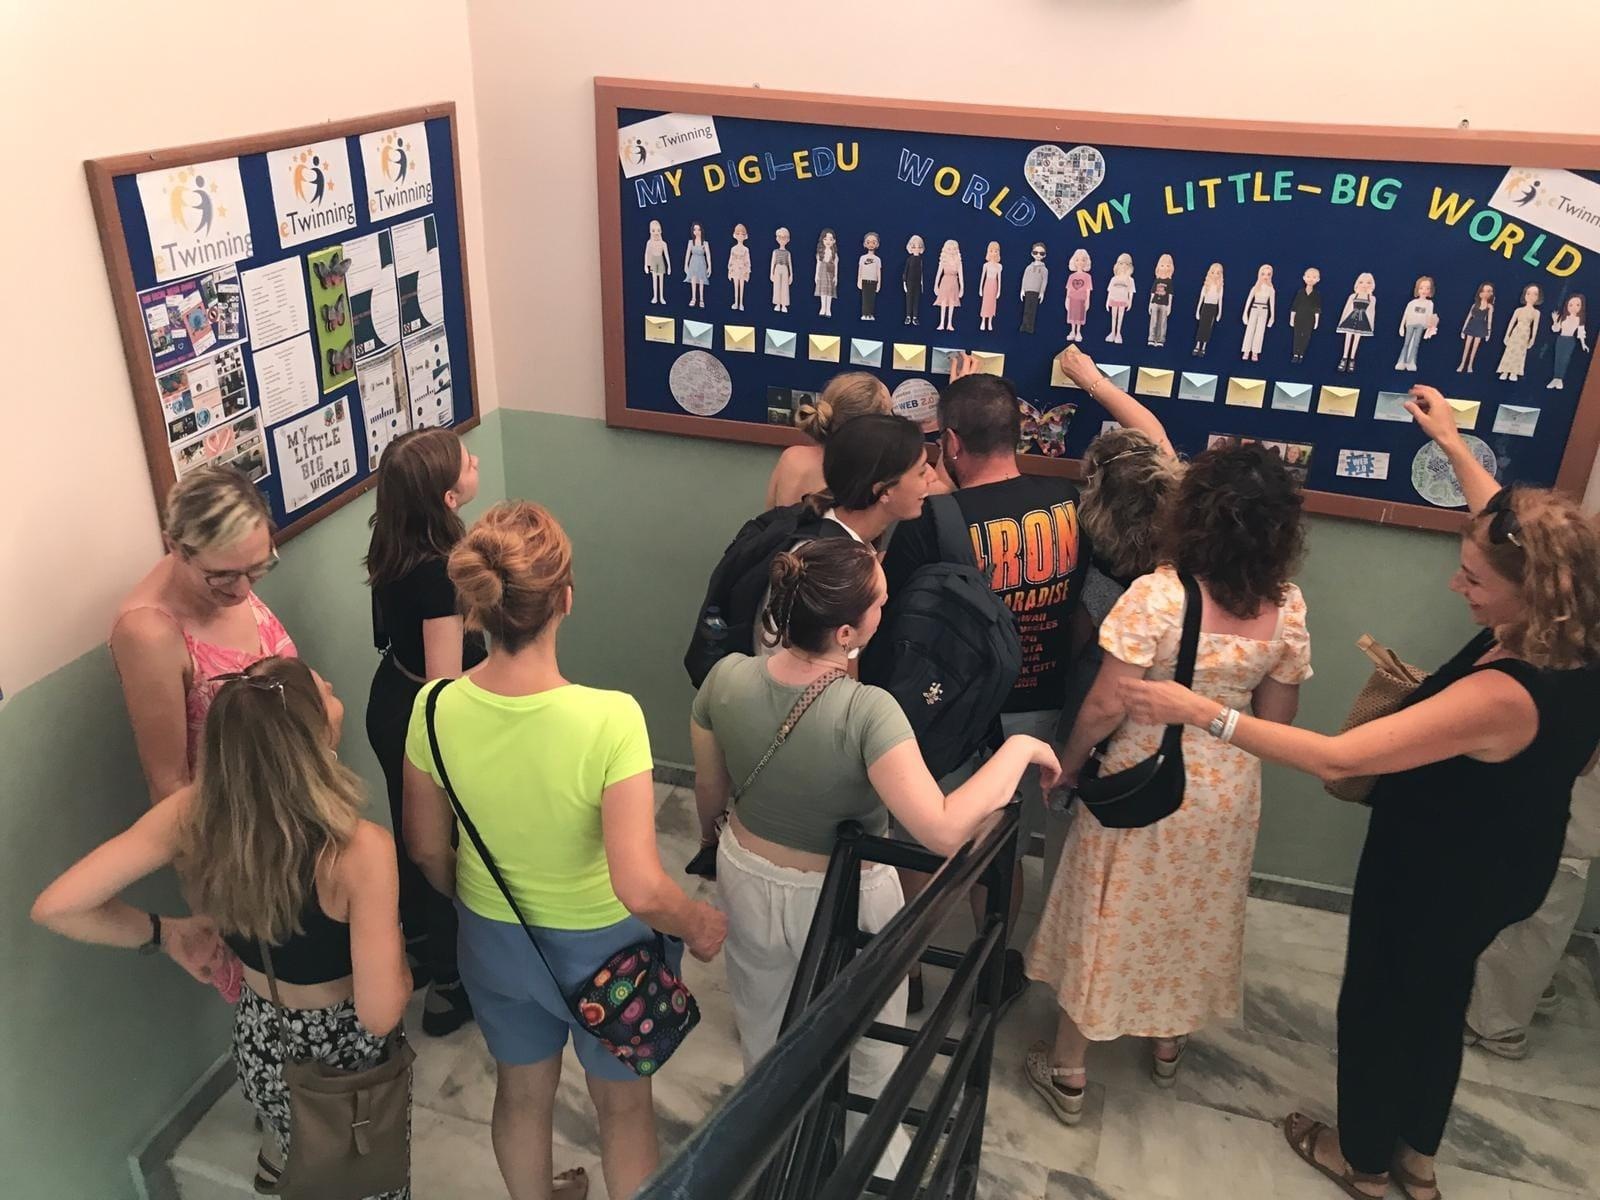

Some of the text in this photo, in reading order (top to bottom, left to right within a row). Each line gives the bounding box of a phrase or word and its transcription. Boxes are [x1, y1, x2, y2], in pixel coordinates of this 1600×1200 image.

[655, 126, 711, 149] eTwinning
[370, 181, 432, 212] eTwinning
[634, 168, 683, 208] MY
[897, 147, 1036, 227] WORLD
[280, 202, 356, 238] eTwinning
[1076, 193, 1132, 238] MY
[1428, 186, 1582, 277] WORLD
[155, 231, 252, 274] eTwinning
[897, 399, 919, 410] WEB
[920, 396, 935, 407] 2.0
[287, 425, 308, 449] MY
[294, 426, 341, 464] LITTLE
[301, 455, 324, 480] BIG
[310, 458, 350, 493] WORLD
[1004, 579, 1070, 612] ARADISE
